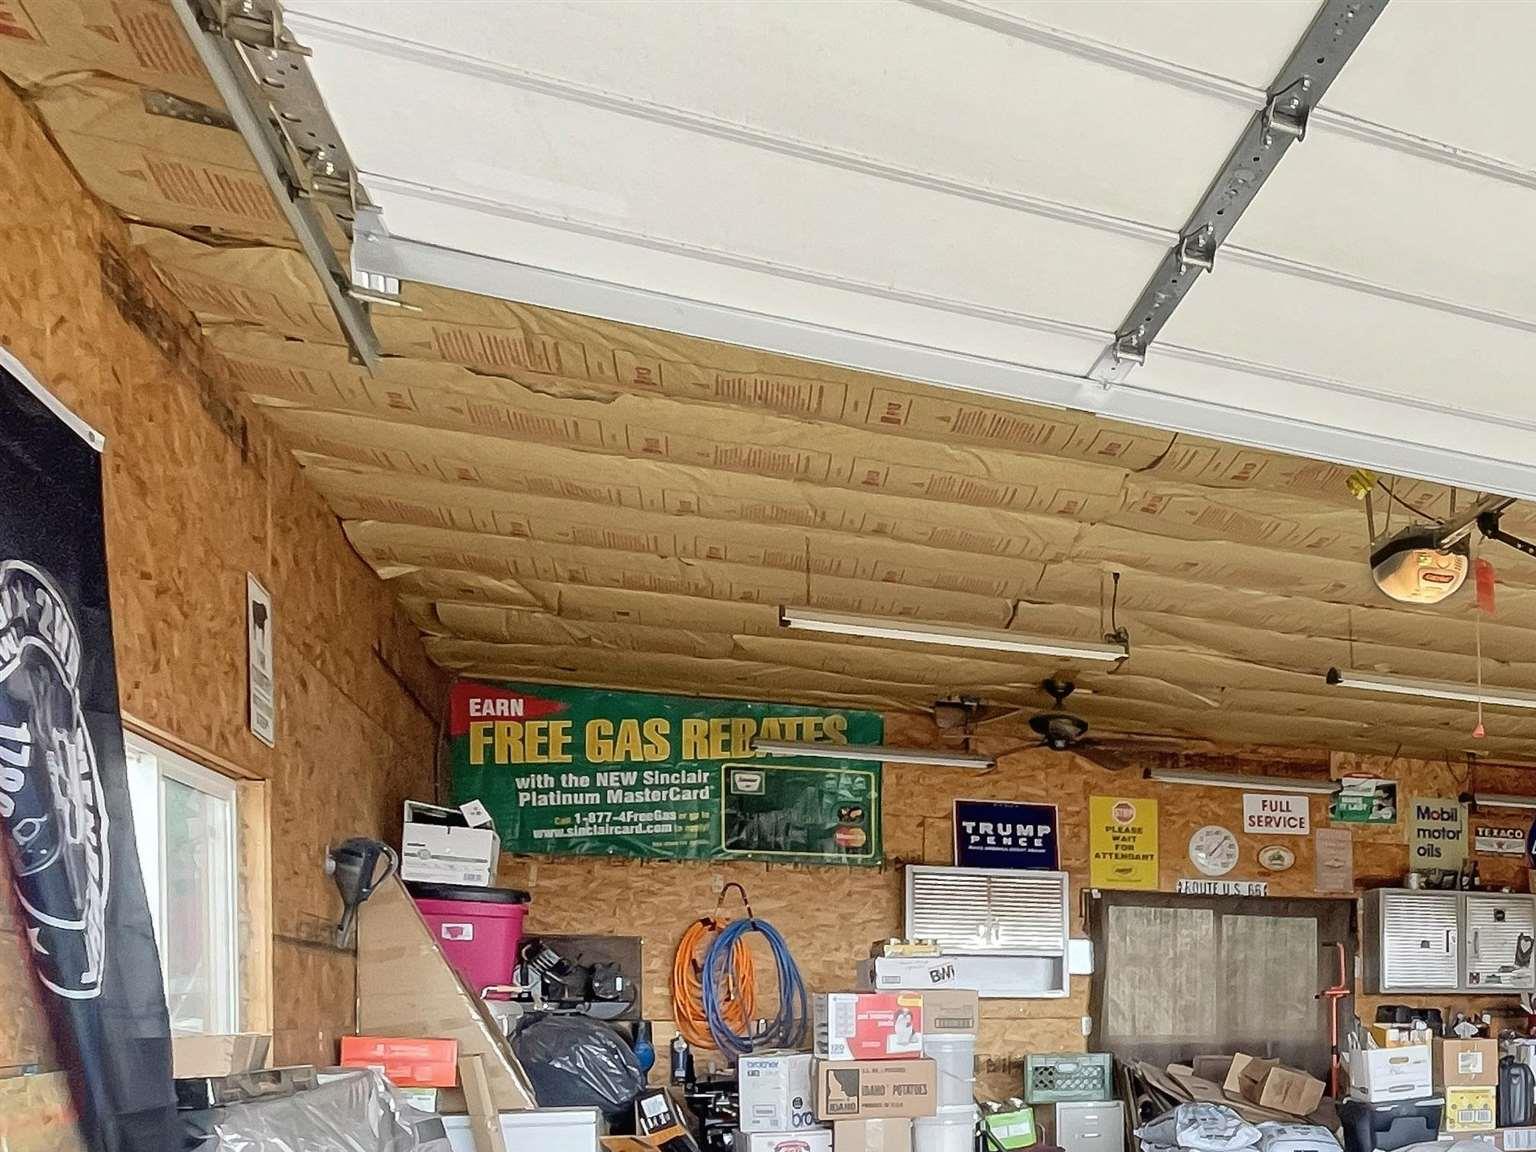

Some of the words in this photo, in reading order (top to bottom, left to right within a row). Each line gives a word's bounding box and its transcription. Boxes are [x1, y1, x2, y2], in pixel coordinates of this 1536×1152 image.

[469, 698, 524, 716] EARN
[469, 719, 573, 765] FREE
[585, 717, 671, 764] GAS
[681, 714, 848, 761] REBATES
[515, 774, 555, 790] with
[561, 772, 590, 788] the
[596, 771, 638, 787] NEW
[642, 769, 710, 785] Sinclair
[518, 790, 600, 807] Platinum
[606, 787, 710, 804] MasterCard
[1261, 799, 1292, 813] FULL
[1416, 806, 1458, 821] Mobil
[962, 821, 1051, 837] TRUMP
[1248, 815, 1305, 829] SERVICE
[532, 823, 672, 839] www.sinclaircard.com
[1105, 826, 1143, 834] PLEASE
[1416, 827, 1462, 840] motor
[1477, 827, 1524, 838] TEXACO
[970, 835, 1043, 847] PENCE
[1416, 844, 1442, 857] oils
[893, 1084, 927, 1096] POTATOES
